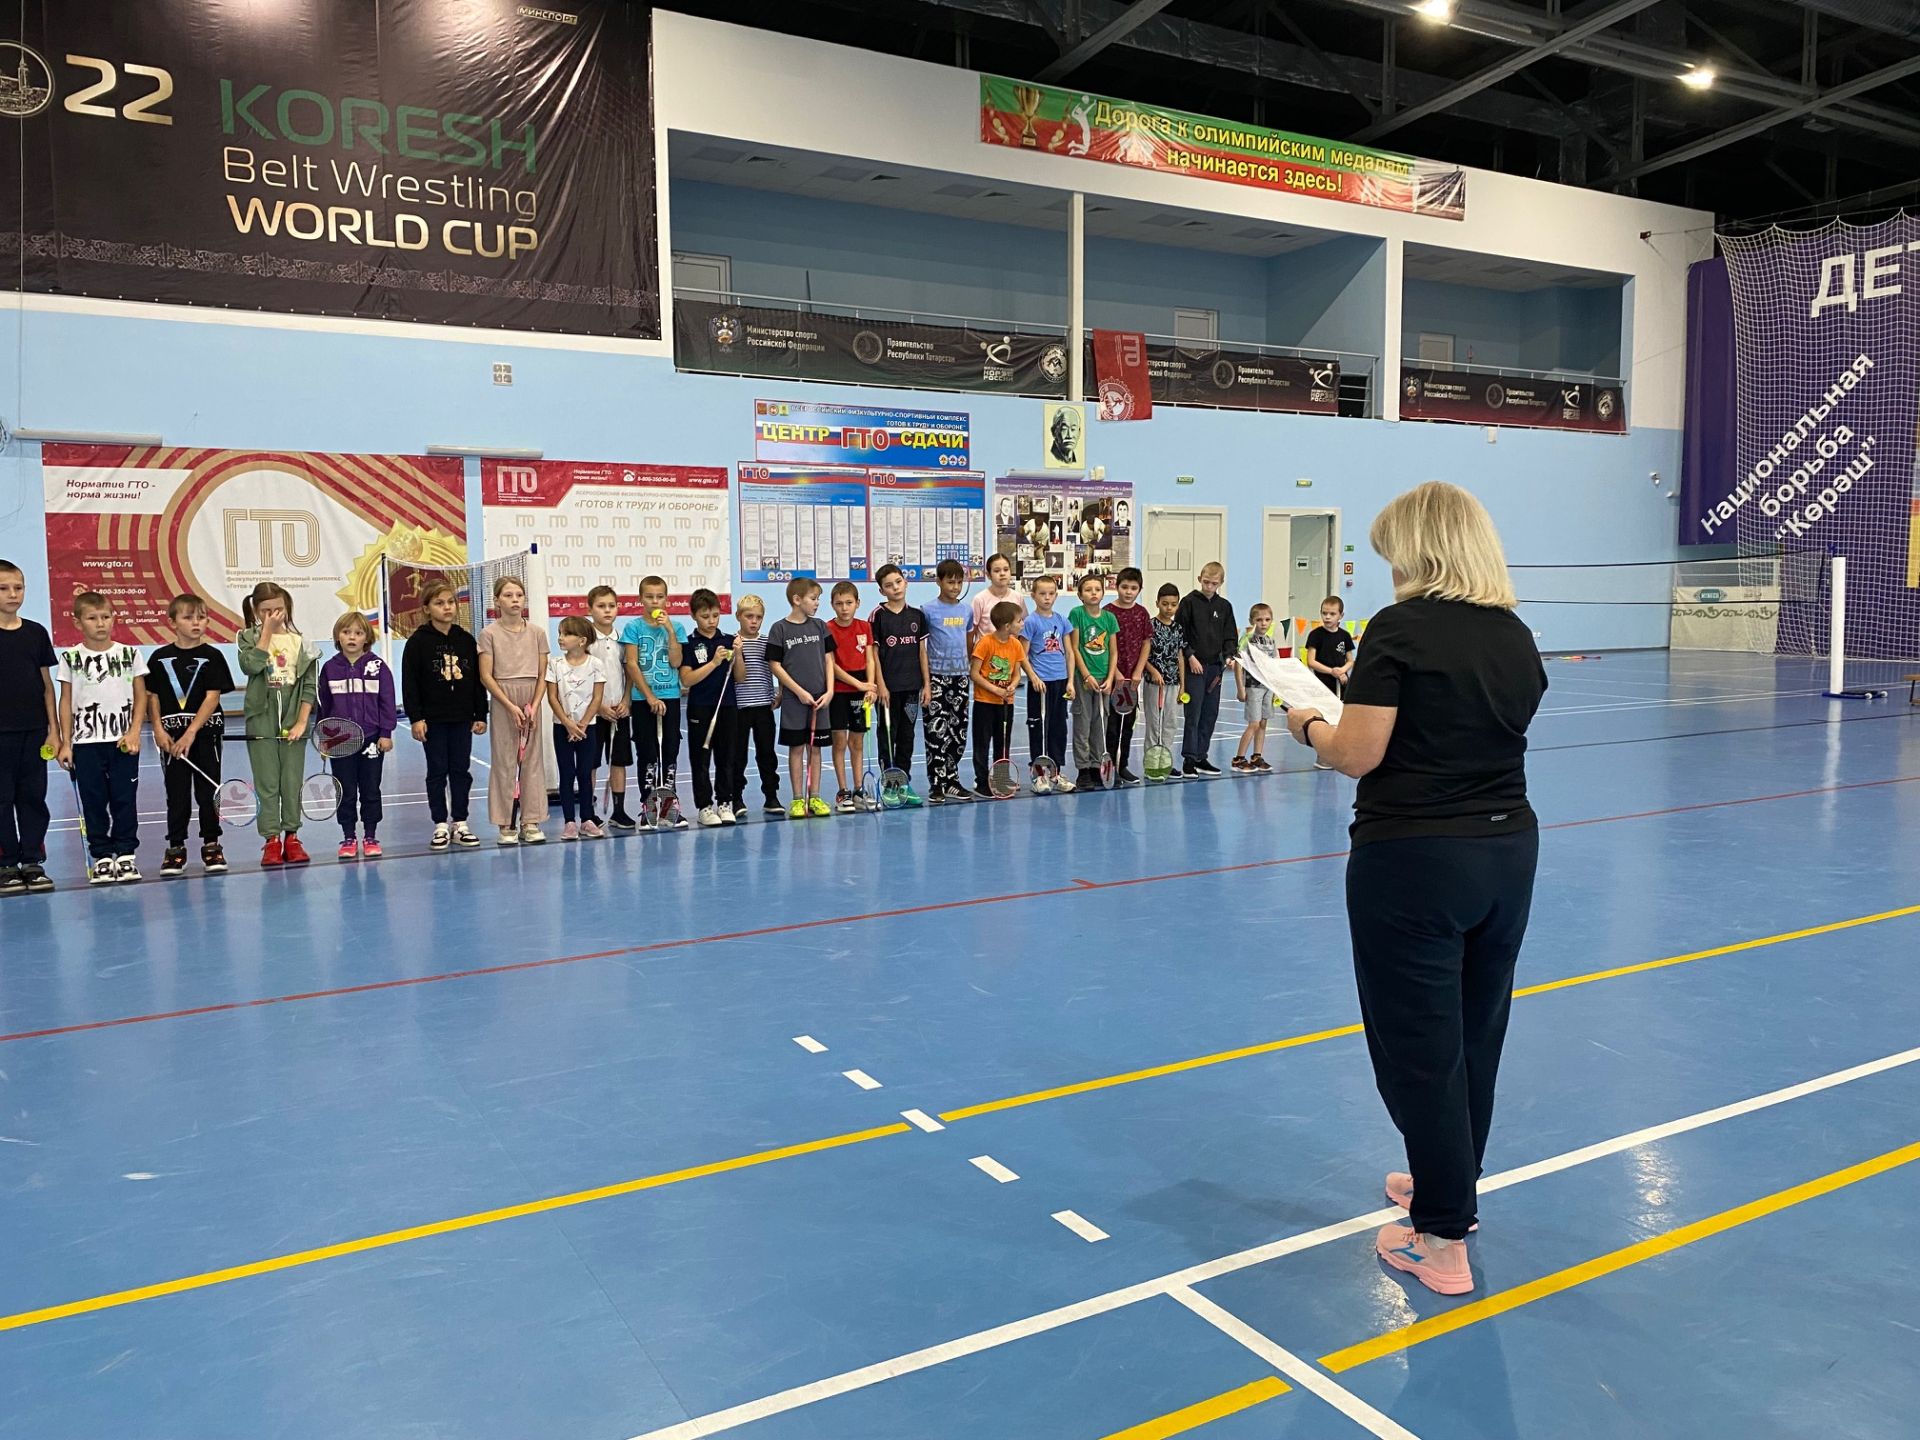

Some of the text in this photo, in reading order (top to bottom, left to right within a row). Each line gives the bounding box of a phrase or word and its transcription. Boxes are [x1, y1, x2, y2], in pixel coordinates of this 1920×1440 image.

[63, 54, 174, 126] 22
[219, 78, 537, 174] KORESH
[1094, 97, 1411, 177] Дорога к олимпийским медалям
[1167, 147, 1344, 194] начинается здесь!
[223, 145, 538, 222] Belt Wrestling
[226, 195, 539, 260] WORLD CUP
[746, 325, 818, 340] Министерство спорта
[747, 336, 787, 348] Российской
[887, 338, 934, 350] Правительство
[887, 349, 925, 361] Республики
[762, 424, 965, 451] ЦЕНТР ГТО СДАЧИ
[1700, 352, 1875, 536] Национальная
[741, 467, 770, 480] ГТО
[1758, 422, 1855, 518] борьба
[66, 479, 124, 489] Норматив
[128, 481, 149, 489] ГТО
[496, 465, 538, 494] ГТО
[870, 472, 897, 485] ГТО
[67, 492, 141, 500] норма жизни!
[574, 499, 719, 512] «ГОТОВ К ТРУДУ И ОБОРОНЕ»
[516, 515, 720, 530] ГТО ГТО ГТО ГТО ГТО ГТО ГТО
[223, 508, 321, 568] ГТО
[500, 534, 705, 548] ГТО ГТО ГТО ГТО ГТО ГТО ГТО
[82, 560, 133, 569] www.gto.ru
[551, 555, 721, 568] ГТО ГТО ГТО ГТО ГТО ГТО
